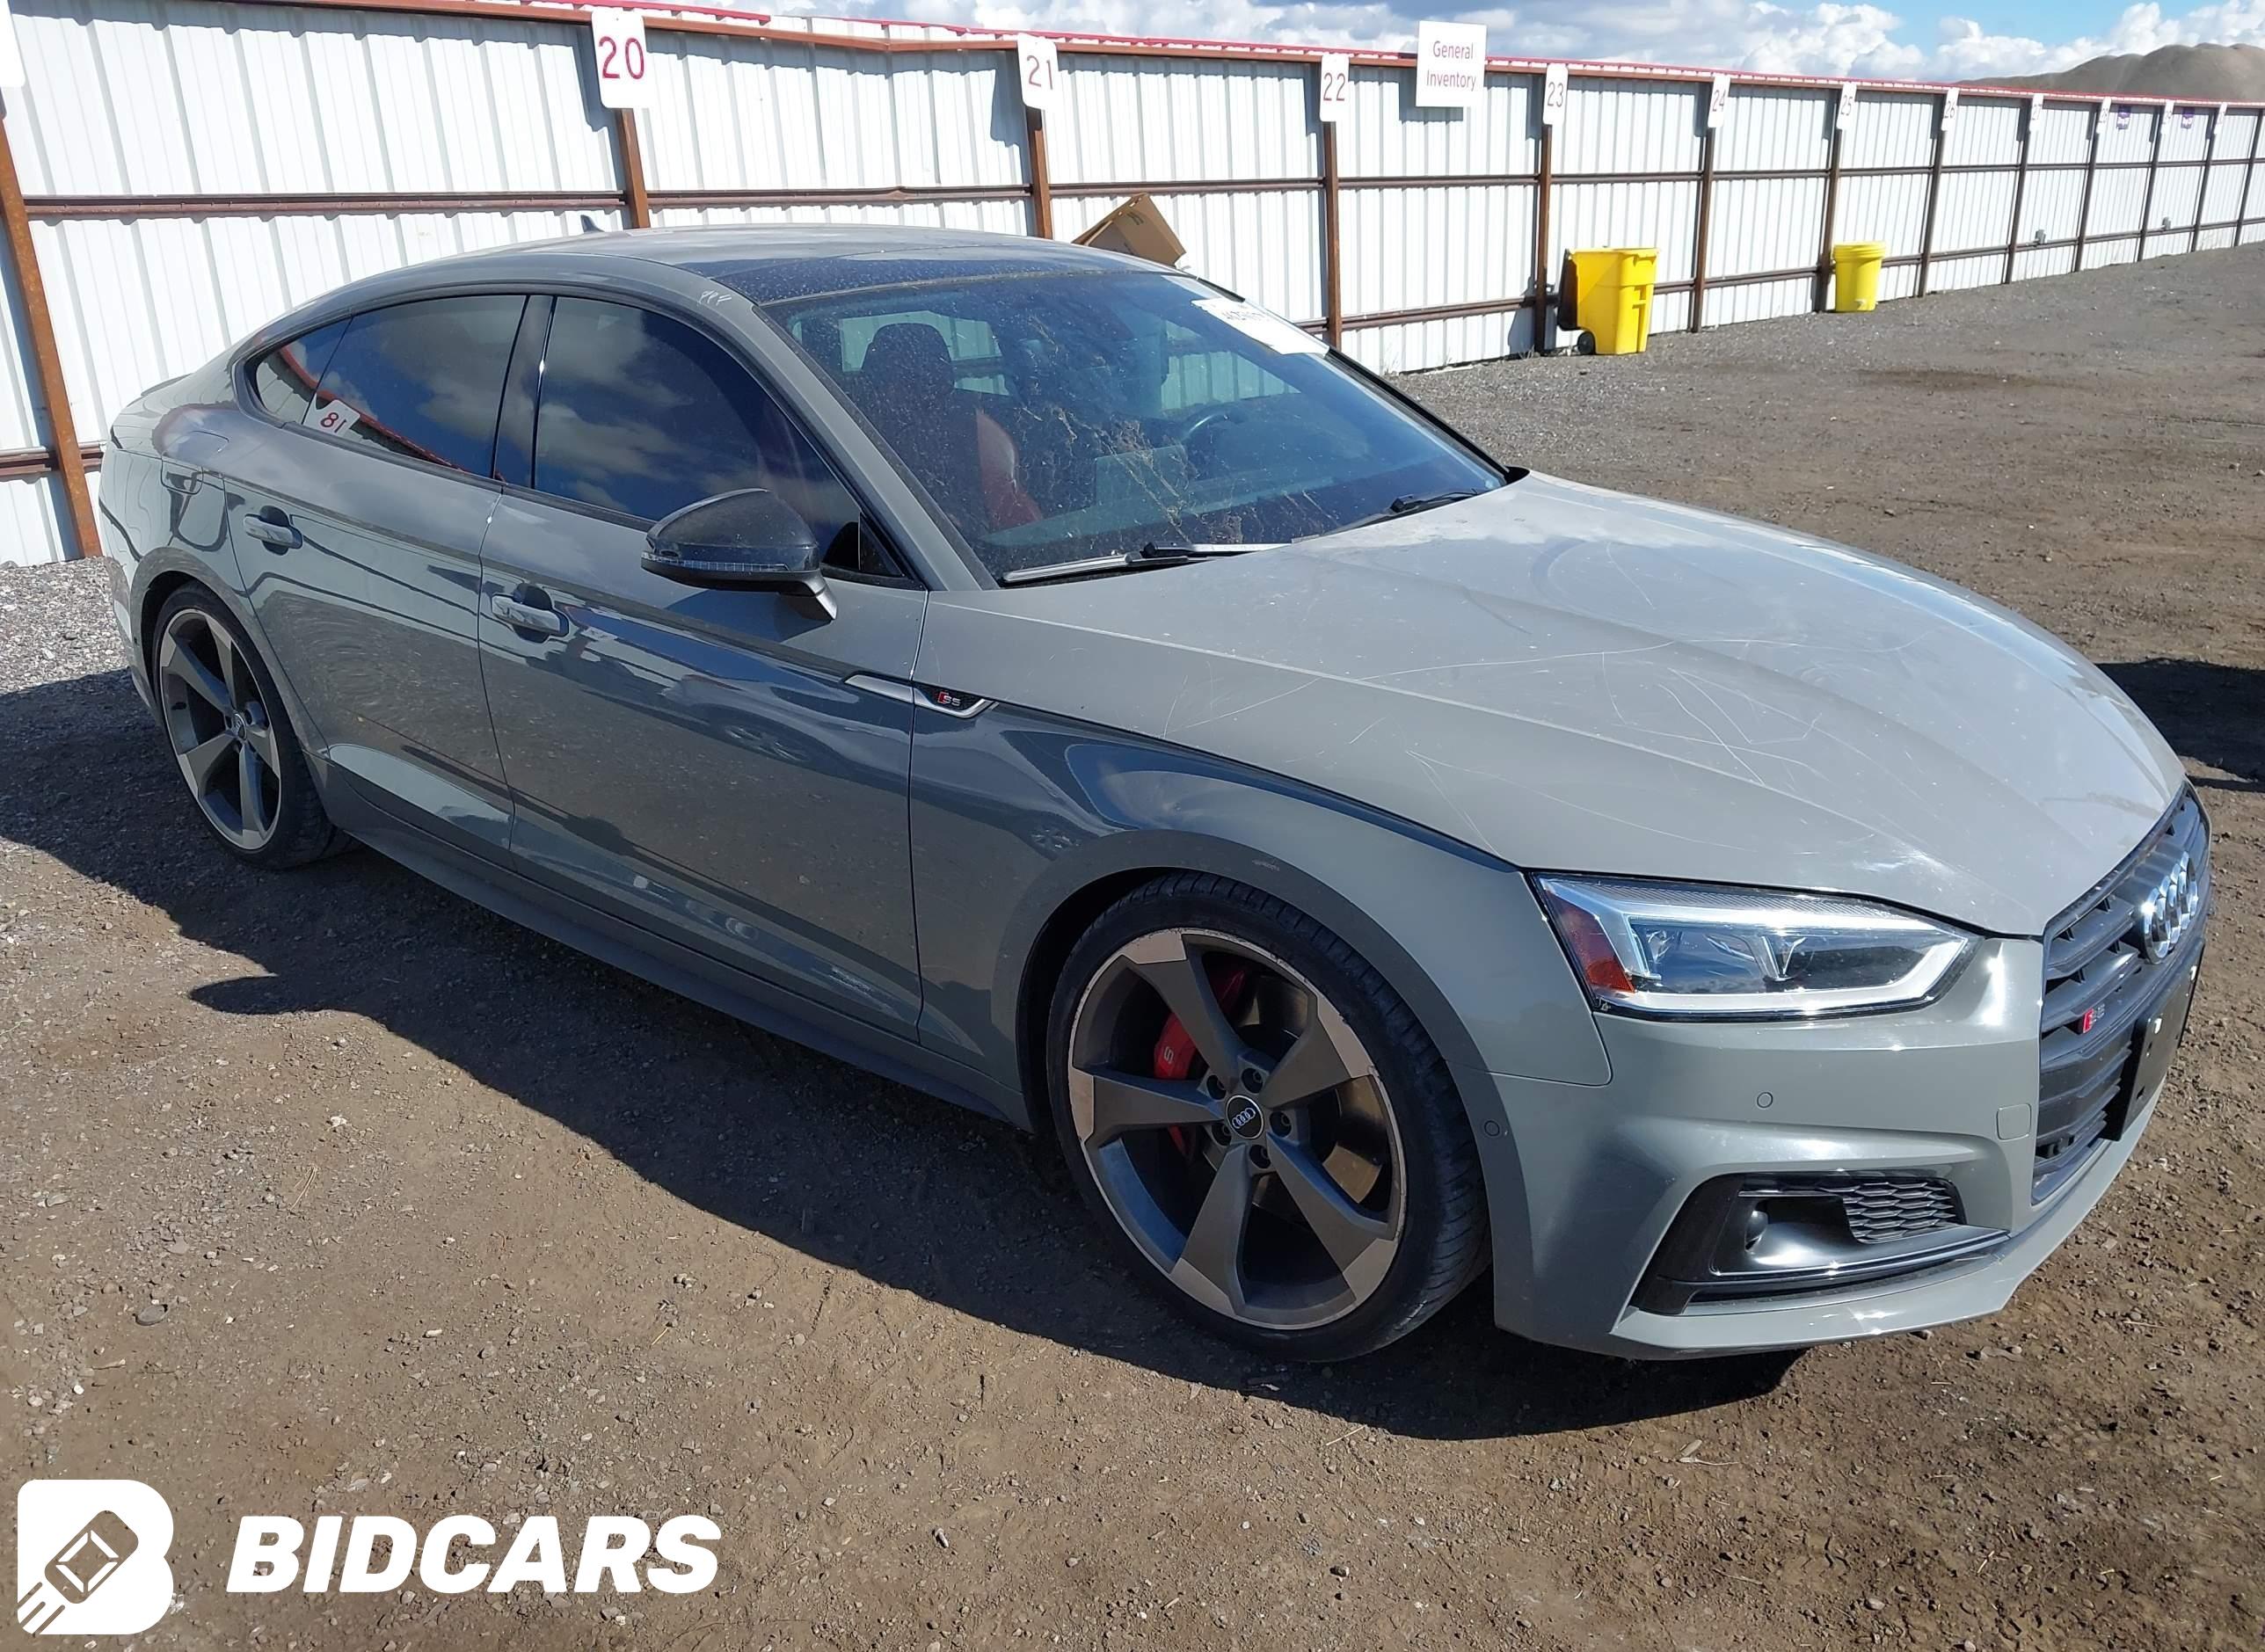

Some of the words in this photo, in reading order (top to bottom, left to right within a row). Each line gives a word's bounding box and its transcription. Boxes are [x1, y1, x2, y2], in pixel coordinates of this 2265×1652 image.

[599, 36, 645, 80] 20
[1432, 40, 1474, 60] General
[1026, 55, 1053, 91] 21
[1426, 69, 1477, 91] Inventory
[1323, 72, 1346, 101] 22
[1547, 81, 1564, 108] 23
[1712, 89, 1726, 113] 24
[1840, 95, 1854, 116] 25
[1943, 99, 1955, 120] 26
[1163, 1046, 1175, 1064] S
